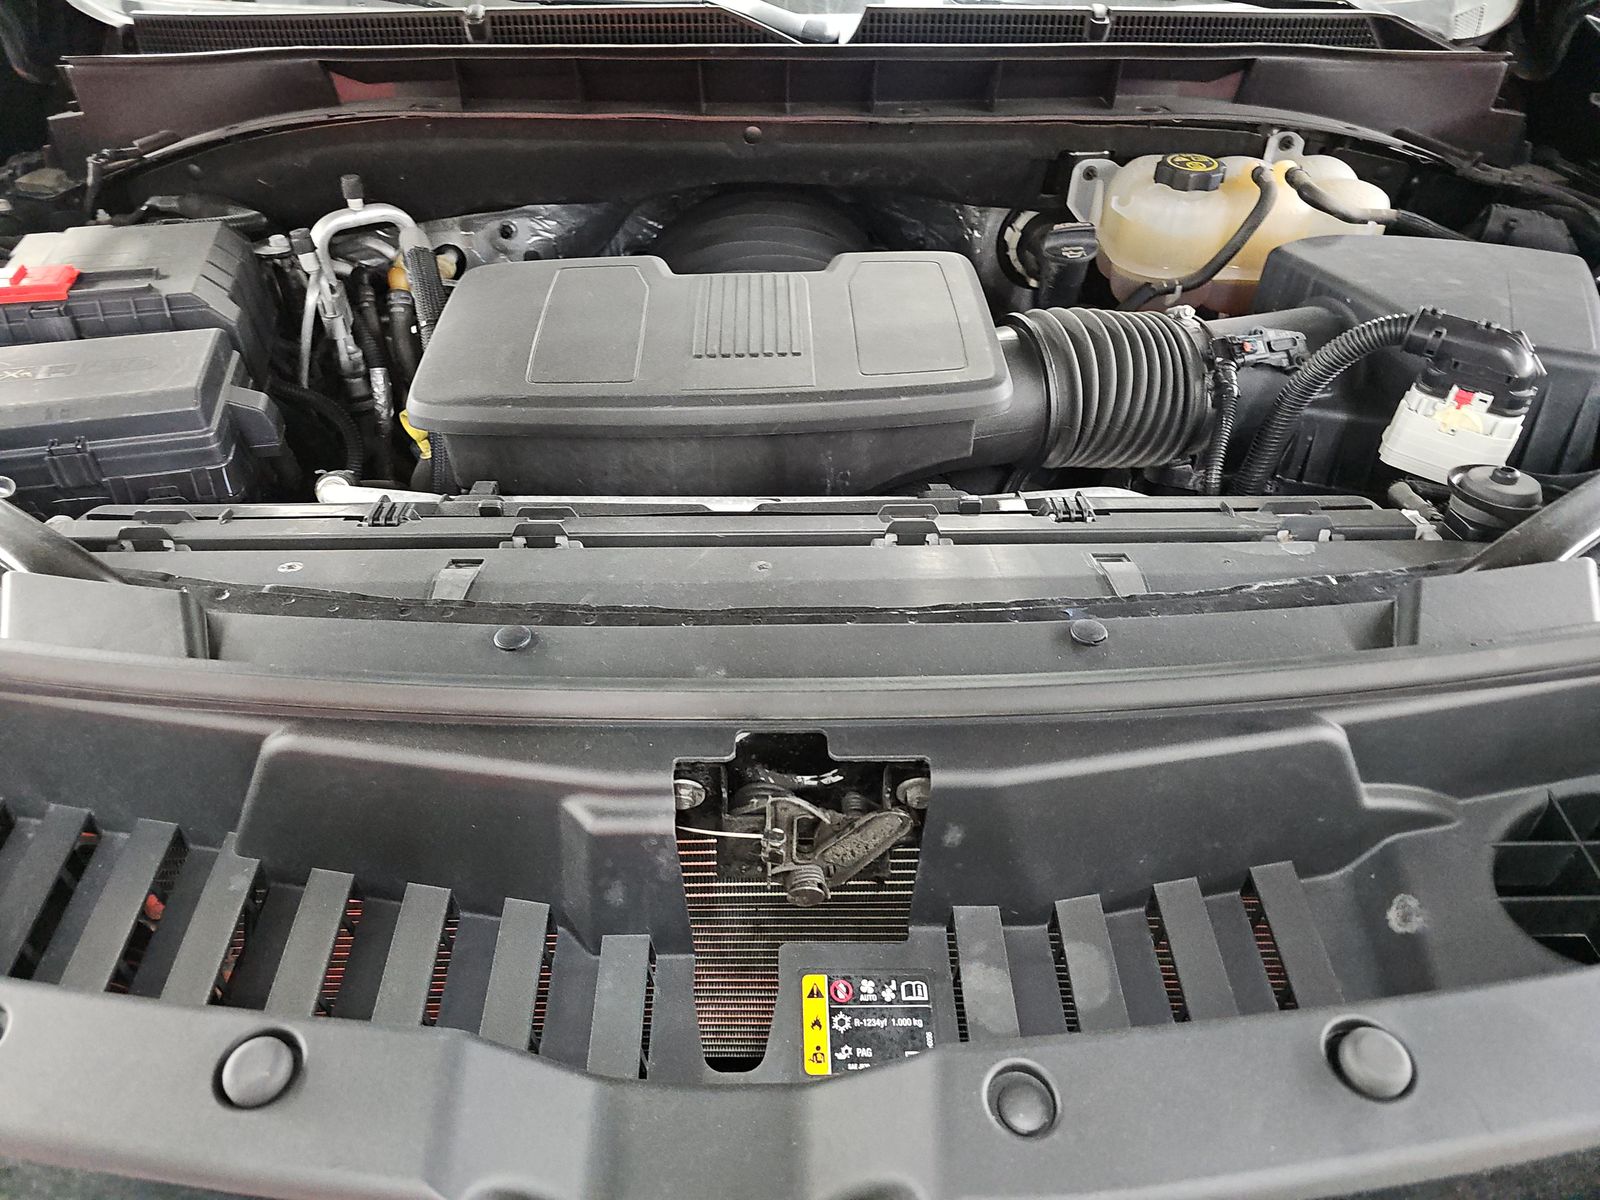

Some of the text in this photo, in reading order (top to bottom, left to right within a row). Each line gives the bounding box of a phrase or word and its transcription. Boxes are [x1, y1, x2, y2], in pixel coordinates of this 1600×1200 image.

[859, 994, 877, 1002] AUTO
[854, 1017, 923, 1028] R-1234yf 1.000 kg
[856, 1047, 873, 1058] PAG
